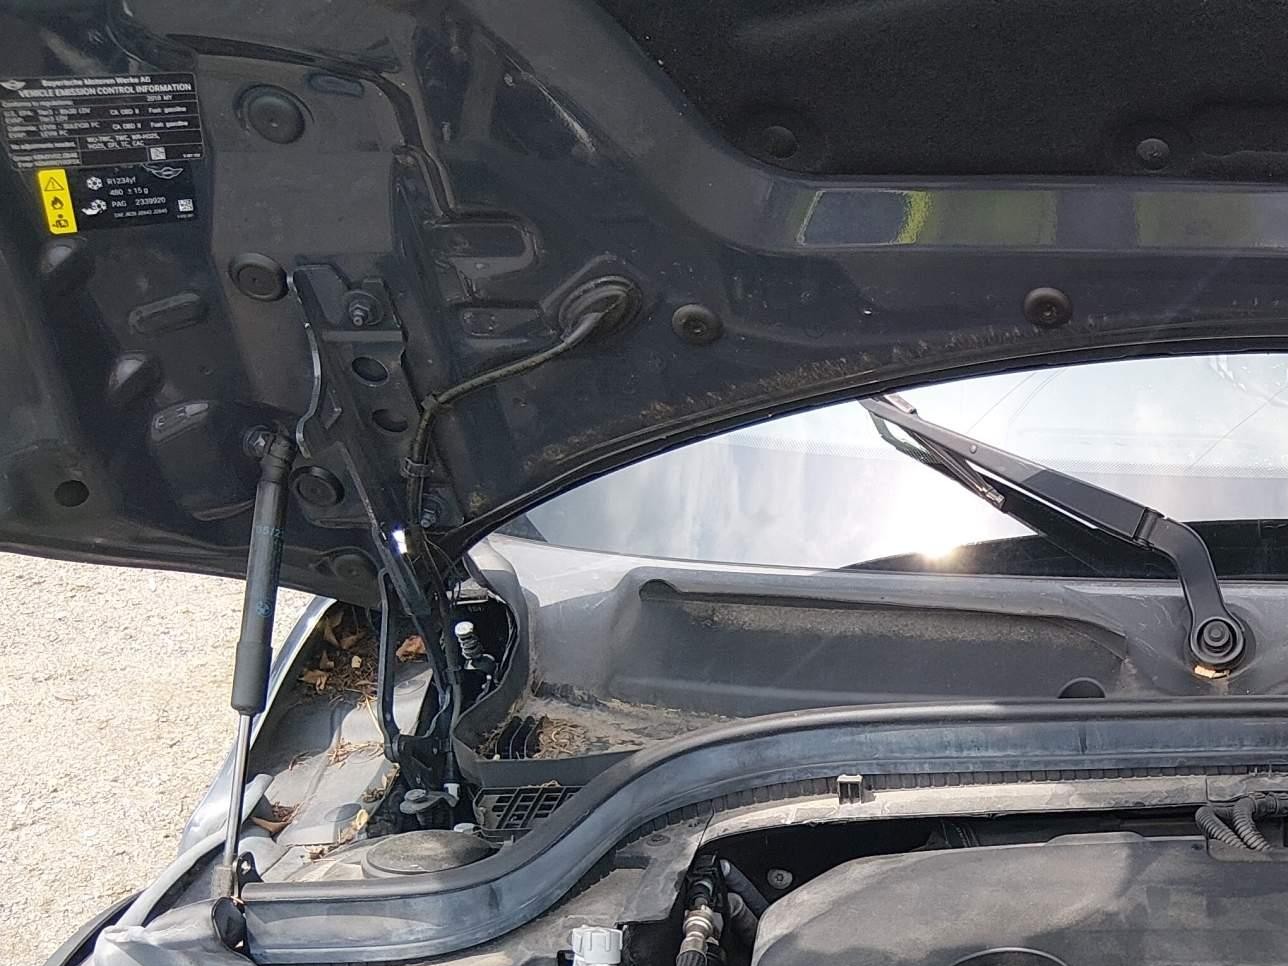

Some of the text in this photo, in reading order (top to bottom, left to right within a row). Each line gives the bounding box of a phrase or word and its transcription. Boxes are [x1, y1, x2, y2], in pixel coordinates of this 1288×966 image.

[115, 76, 139, 84] Werke
[140, 75, 152, 83] AG
[18, 83, 192, 98] VEHICLE EMISSION CONTROL INFORMATION
[106, 175, 136, 185] R1234yf
[112, 199, 127, 207] PAG
